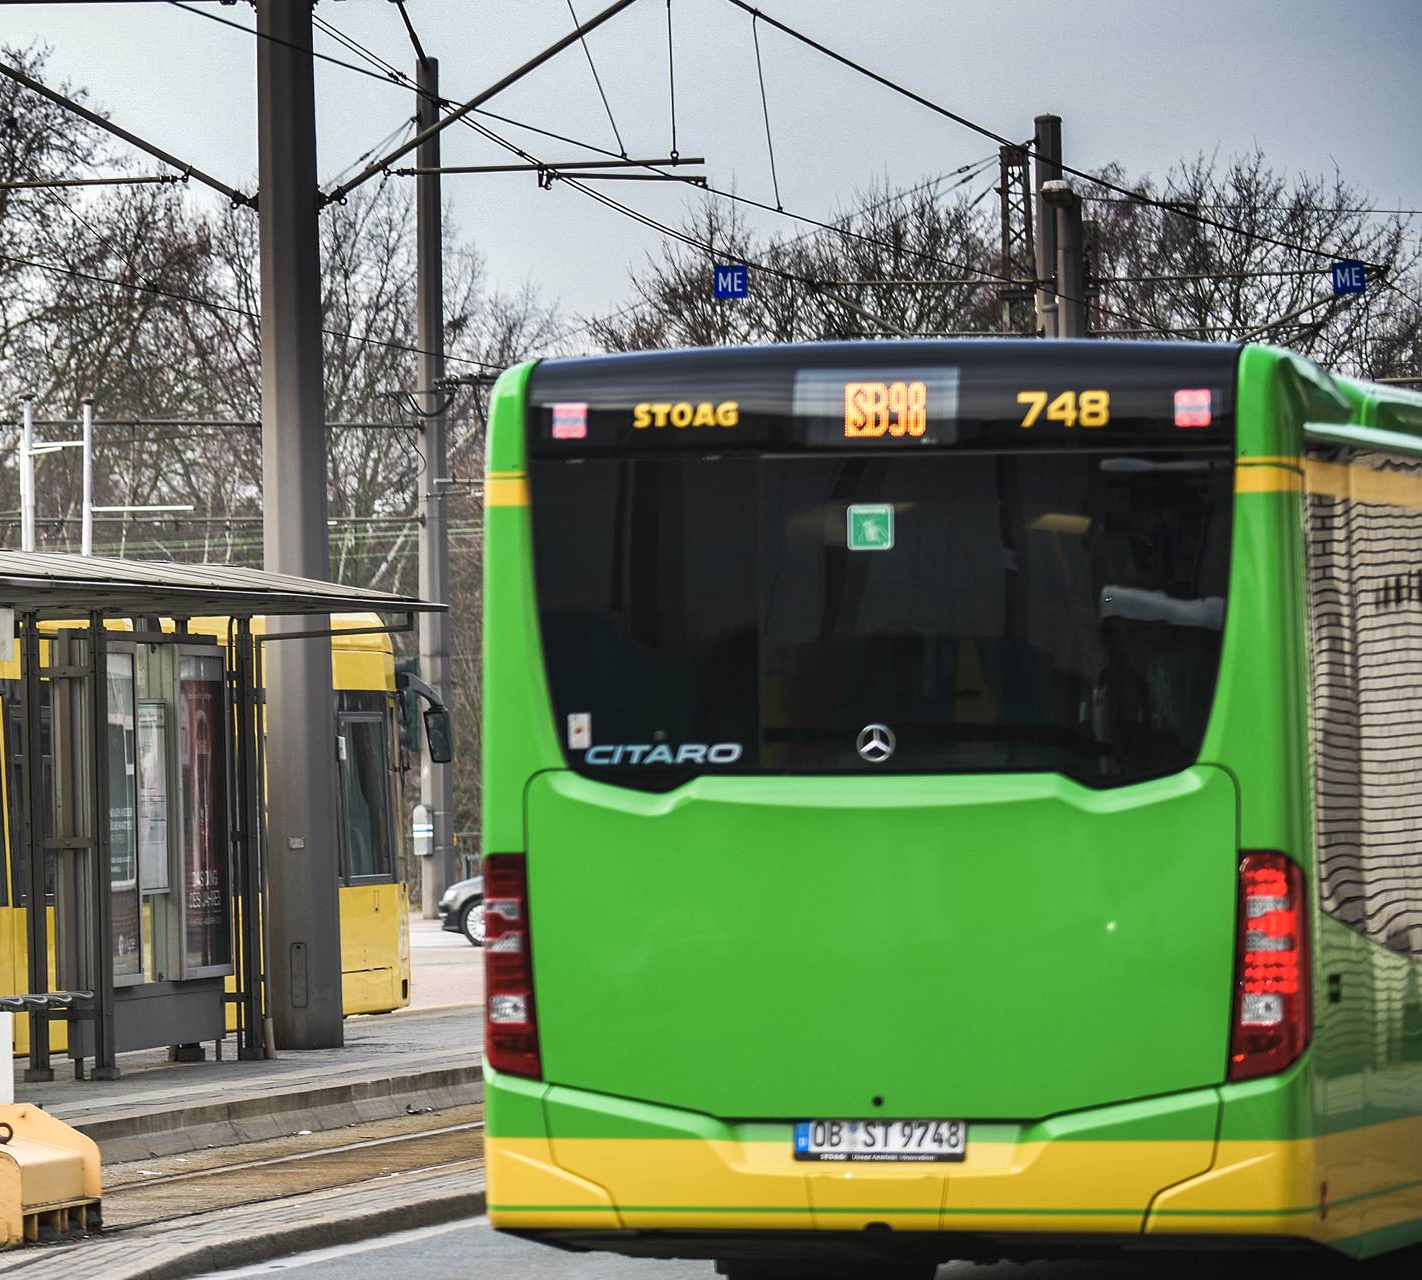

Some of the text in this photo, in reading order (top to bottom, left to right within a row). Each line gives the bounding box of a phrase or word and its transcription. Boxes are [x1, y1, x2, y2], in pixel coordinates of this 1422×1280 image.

[718, 272, 743, 293] ME
[1336, 267, 1362, 288] ME
[633, 402, 739, 429] STOAG
[844, 382, 927, 438] SB98
[1016, 390, 1111, 428] 748
[584, 743, 743, 765] CITARO
[813, 1120, 961, 1148] OB ST 9748
